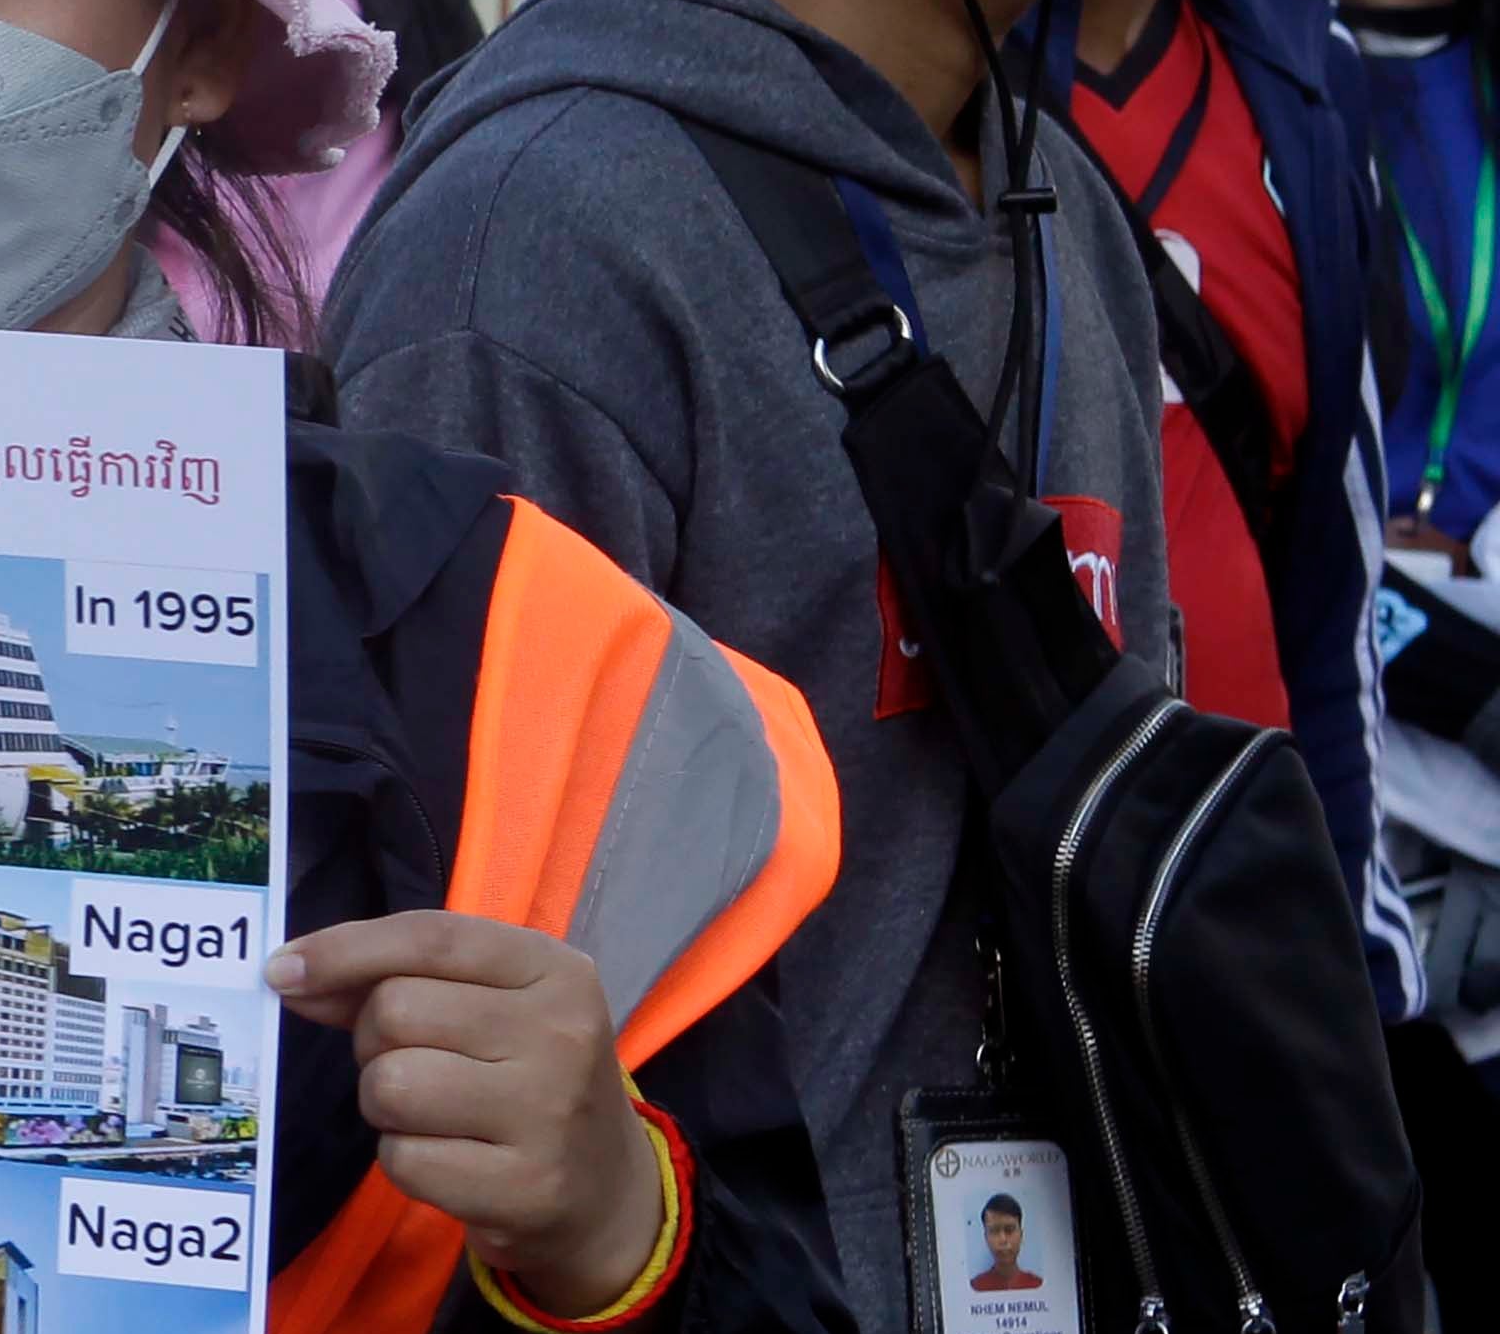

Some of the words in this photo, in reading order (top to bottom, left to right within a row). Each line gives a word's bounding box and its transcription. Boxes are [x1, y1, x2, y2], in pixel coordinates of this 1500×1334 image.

[75, 585, 116, 627] In
[134, 590, 255, 637] 1995
[83, 904, 249, 968] Naga1
[68, 1202, 241, 1267] Naga2
